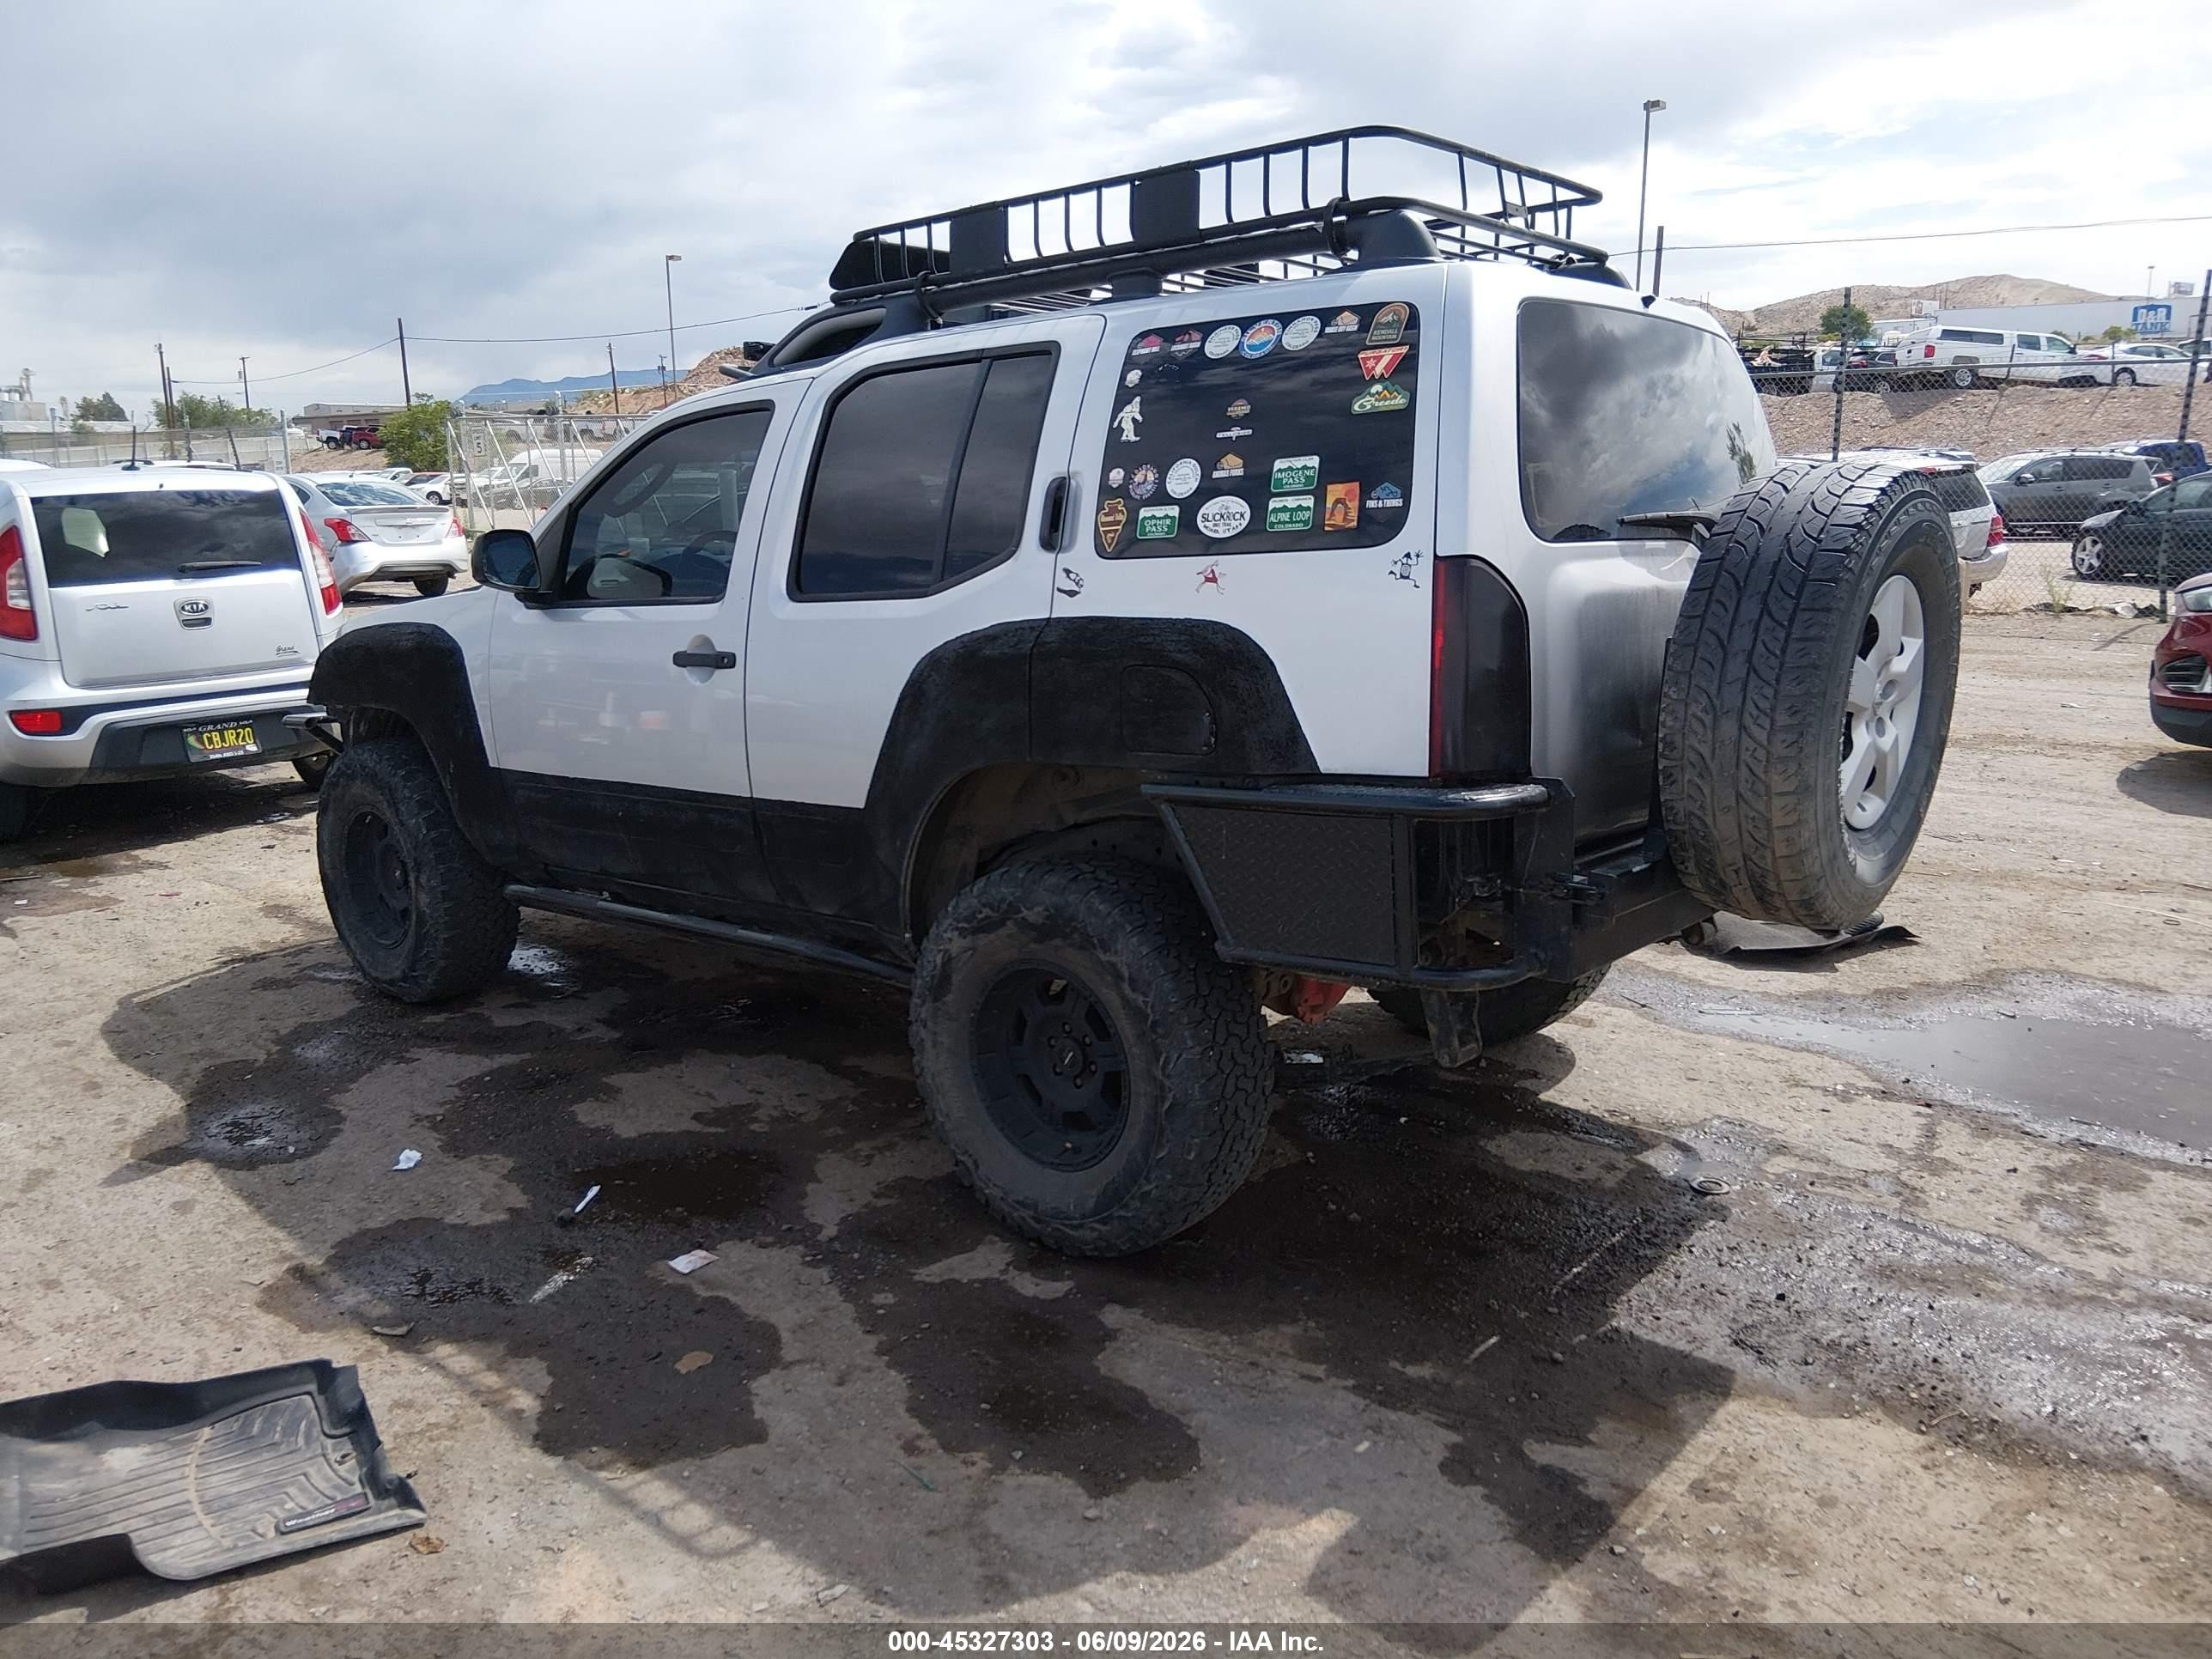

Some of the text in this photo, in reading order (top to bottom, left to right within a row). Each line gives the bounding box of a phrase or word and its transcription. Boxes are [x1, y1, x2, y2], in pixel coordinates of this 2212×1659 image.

[477, 442, 482, 453] 5
[1275, 469, 1315, 479] IMOGENE
[1366, 500, 1377, 508] FINS
[1383, 498, 1403, 507] THINGS
[1201, 511, 1246, 523] SLICKROCK
[1270, 511, 1310, 522] ALPINE LOOP
[184, 603, 206, 611] KIA
[198, 722, 237, 732] GRAND
[203, 727, 254, 750] CBJR20
